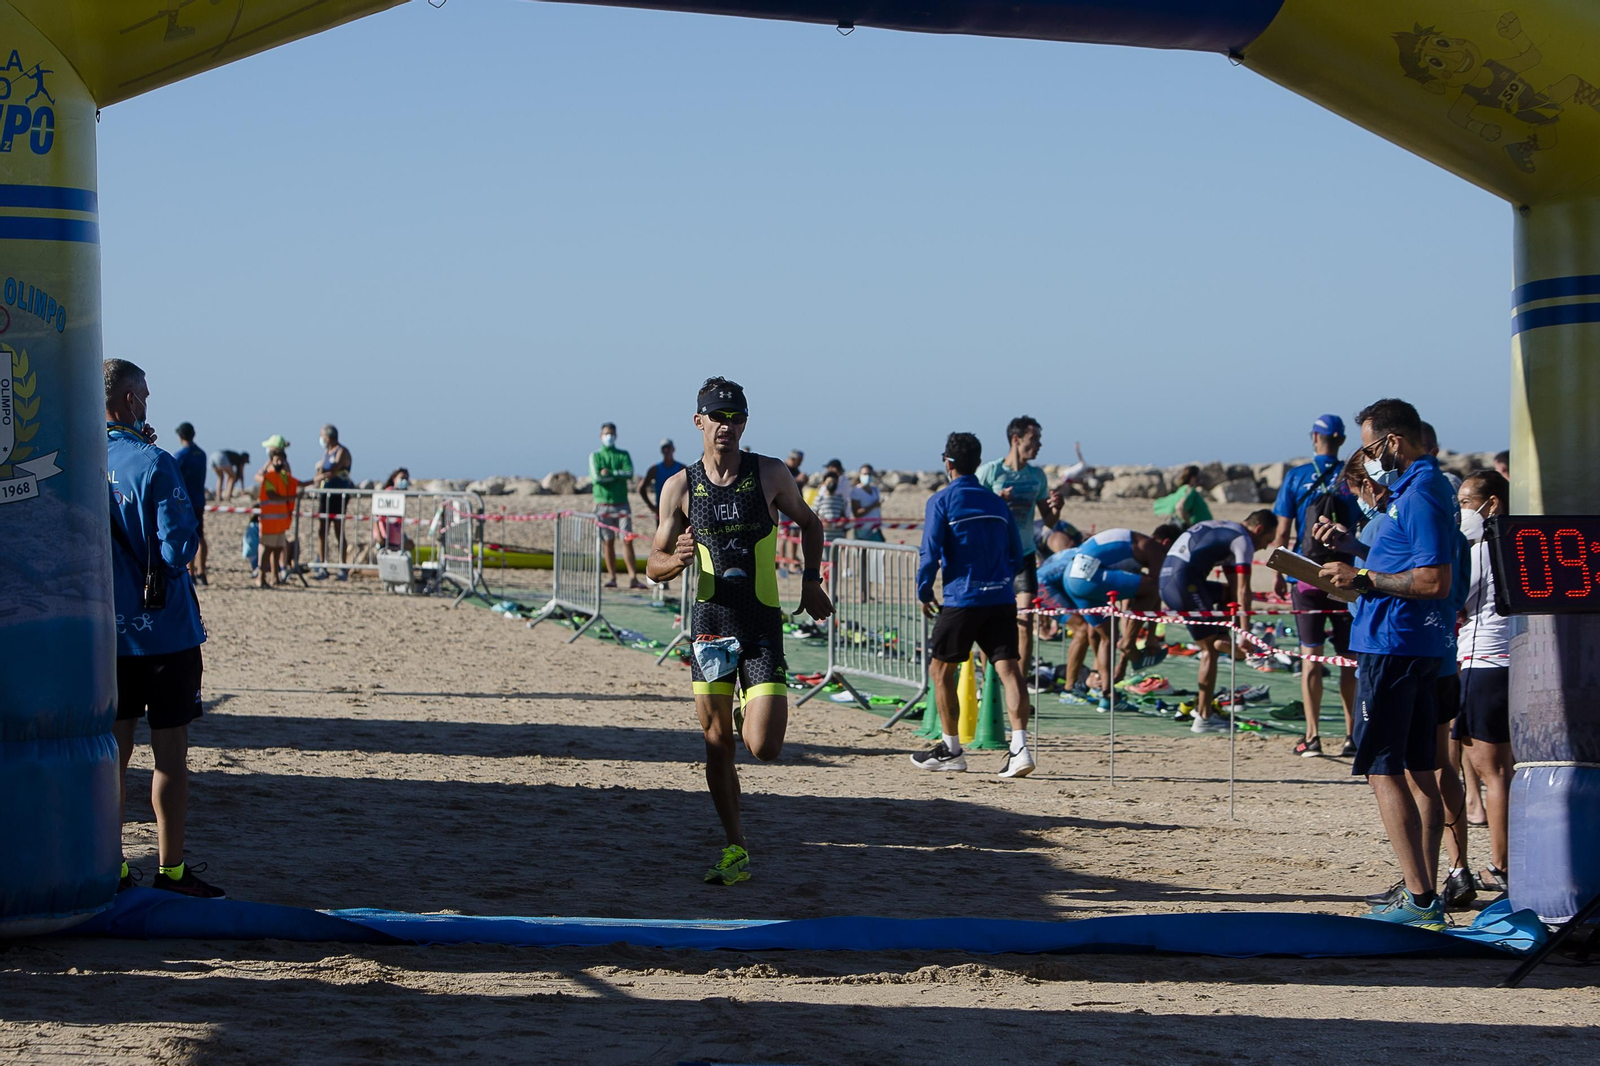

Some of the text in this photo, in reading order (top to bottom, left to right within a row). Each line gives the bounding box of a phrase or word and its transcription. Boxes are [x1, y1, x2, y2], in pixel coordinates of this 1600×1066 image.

[0, 103, 55, 155] PO
[4, 276, 66, 333] OLIMPO
[1, 378, 11, 426] OLIMPO
[2, 482, 31, 498] 1968
[713, 502, 740, 521] VELA
[725, 522, 761, 534] BARROSA
